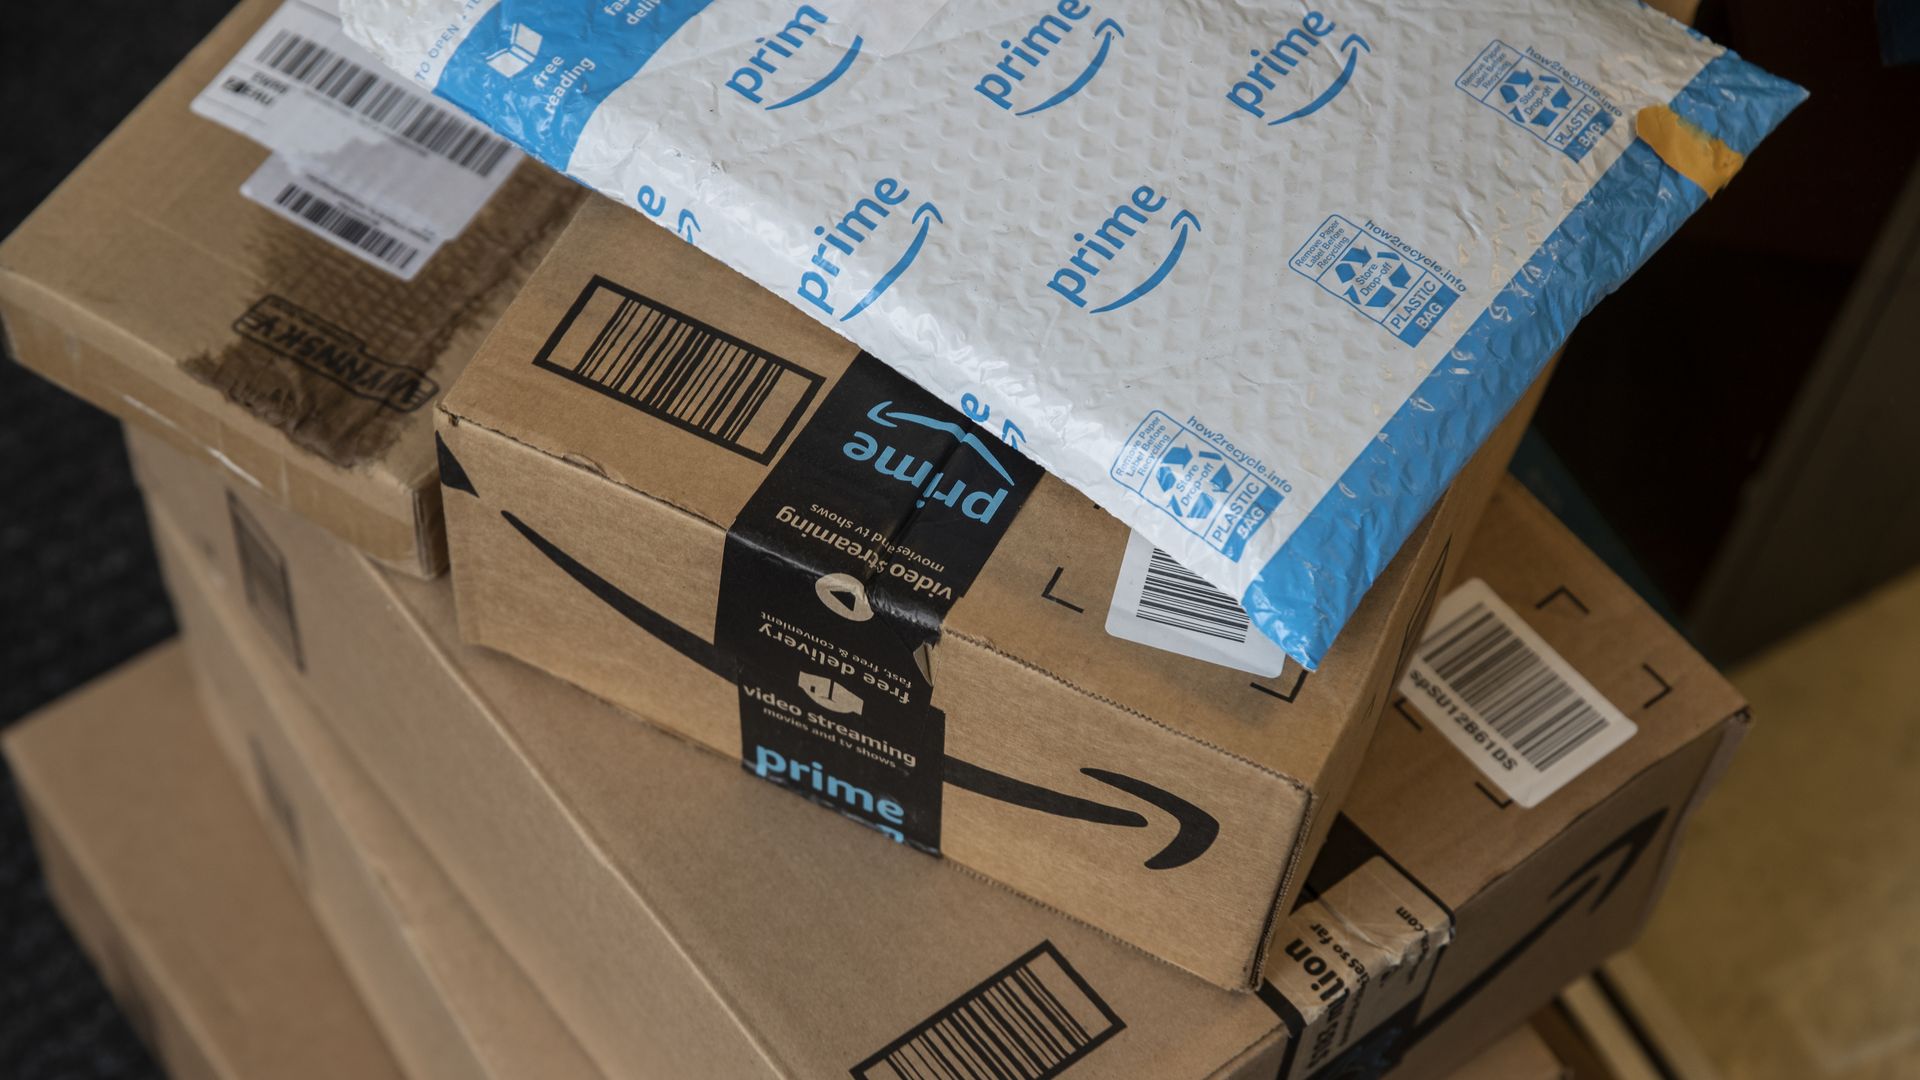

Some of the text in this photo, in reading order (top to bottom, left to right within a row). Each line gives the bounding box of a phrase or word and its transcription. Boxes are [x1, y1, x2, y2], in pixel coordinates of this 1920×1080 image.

[414, 24, 460, 80] TO OPEN
[532, 55, 566, 89] free
[725, 4, 828, 104] prim
[973, 0, 1091, 110] prime
[1225, 10, 1337, 119] prime
[543, 57, 596, 116] reading
[1520, 84, 1540, 105] Store
[1525, 46, 1623, 118] how2recycle.info
[1554, 103, 1596, 145] PLASTIC
[1578, 120, 1604, 148] BAG
[797, 177, 910, 316] prime
[1046, 185, 1167, 309] prime
[1294, 220, 1340, 267] Remove Paper
[1305, 227, 1345, 269] Label Before
[1317, 236, 1350, 270] Recycling
[1364, 220, 1467, 293] how2recycle.info
[1355, 263, 1378, 286] Store
[1359, 262, 1393, 297] Drop-off
[1389, 280, 1437, 331] PLASTIC
[1415, 302, 1444, 330] BAG
[1115, 416, 1161, 477] Remove Paper
[1126, 424, 1167, 478] Label Before
[1137, 434, 1171, 477] Recycling
[1187, 415, 1292, 494] how2recycle.info
[842, 431, 1009, 525] prime
[1175, 463, 1200, 493] Store
[1180, 462, 1214, 507] Drop-off
[810, 503, 855, 530] shows
[855, 525, 870, 539] tv
[1212, 481, 1260, 543] PLASTIC
[1236, 504, 1266, 540] BAG
[775, 504, 954, 600] video streaming
[897, 545, 946, 574] movies
[758, 622, 911, 705] free delivery
[760, 611, 913, 689] fast, free & convenient
[743, 684, 917, 768] video streaming
[763, 706, 897, 769] movies and tv shows
[755, 744, 905, 825] prime
[1309, 922, 1333, 946] far
[1332, 943, 1351, 960] so
